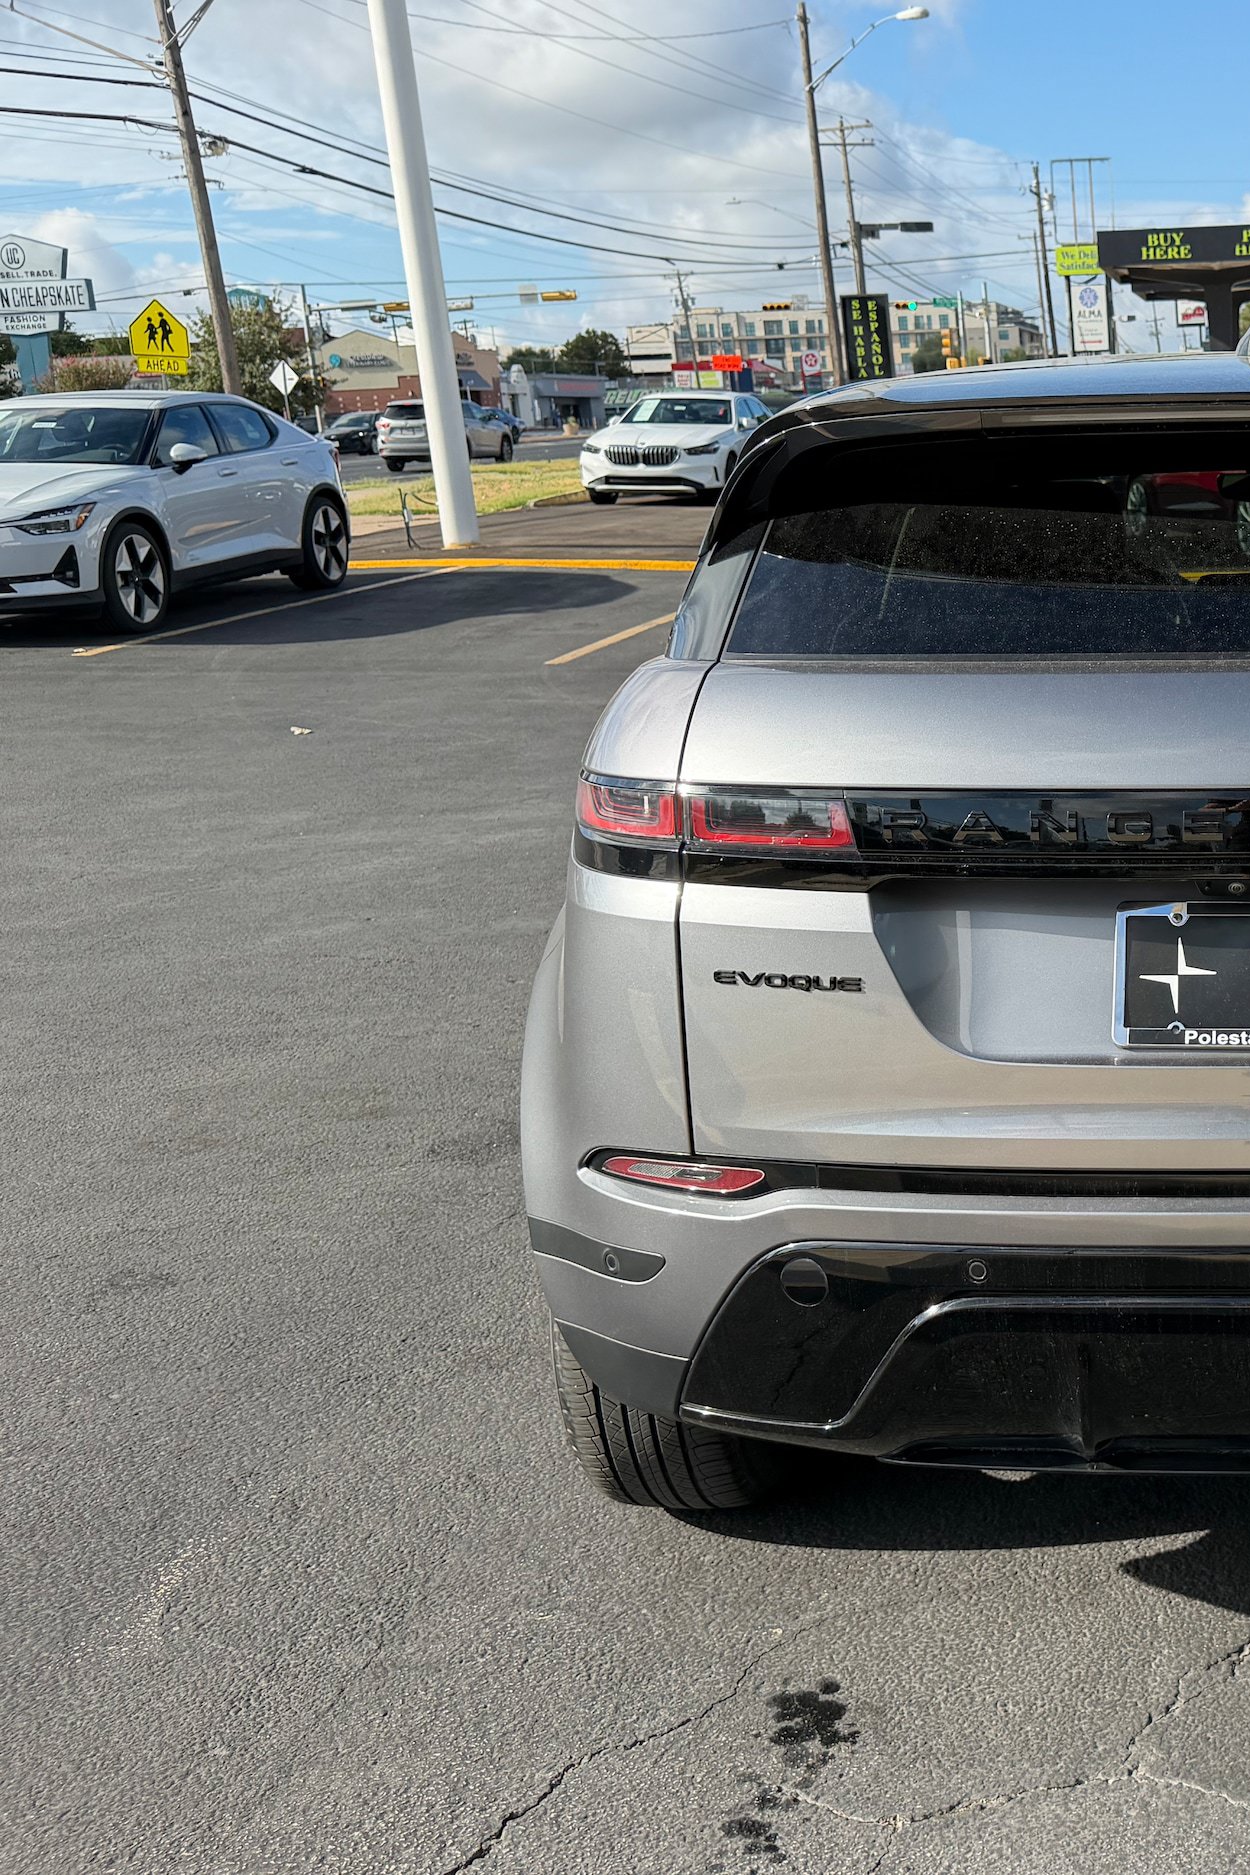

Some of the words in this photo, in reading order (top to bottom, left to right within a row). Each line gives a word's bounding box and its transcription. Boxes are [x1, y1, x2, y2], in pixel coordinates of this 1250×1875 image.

[1147, 232, 1184, 247] BUY
[6, 247, 20, 265] UC
[1061, 251, 1076, 260] We
[1141, 245, 1193, 260] HERE
[11, 285, 85, 308] CHEAPSKATE
[851, 299, 862, 321] SE
[4, 314, 46, 324] FASHION
[5, 322, 47, 331] EXCHANGE
[146, 359, 180, 372] AHEAD
[882, 807, 1226, 845] RANGE
[713, 969, 867, 993] EVOQUE
